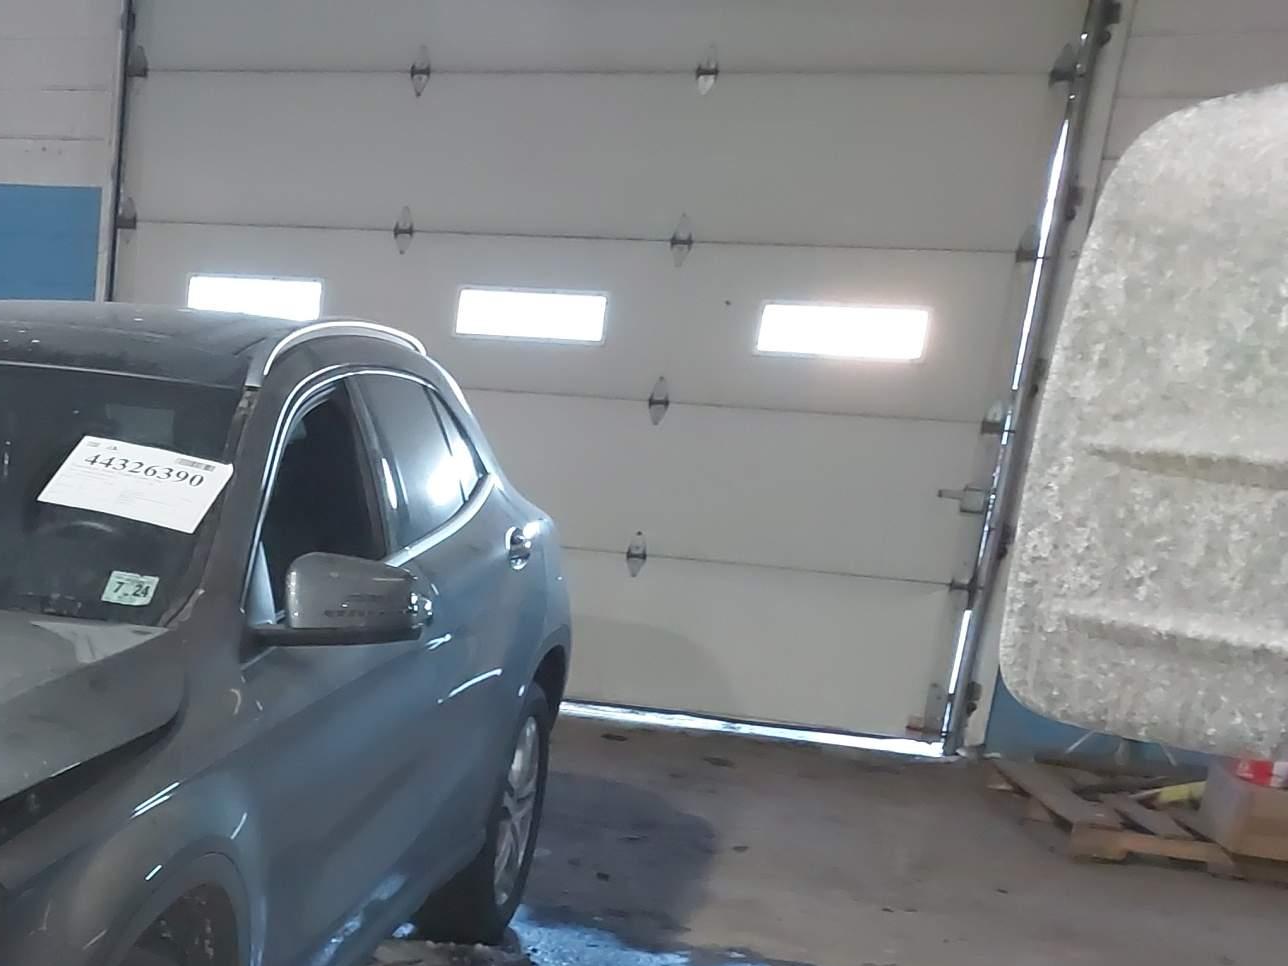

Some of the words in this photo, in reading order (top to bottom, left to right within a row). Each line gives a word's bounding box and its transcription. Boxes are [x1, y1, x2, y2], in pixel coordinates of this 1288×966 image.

[84, 453, 205, 487] 44326390
[112, 581, 125, 593] 7
[132, 583, 151, 598] 24
